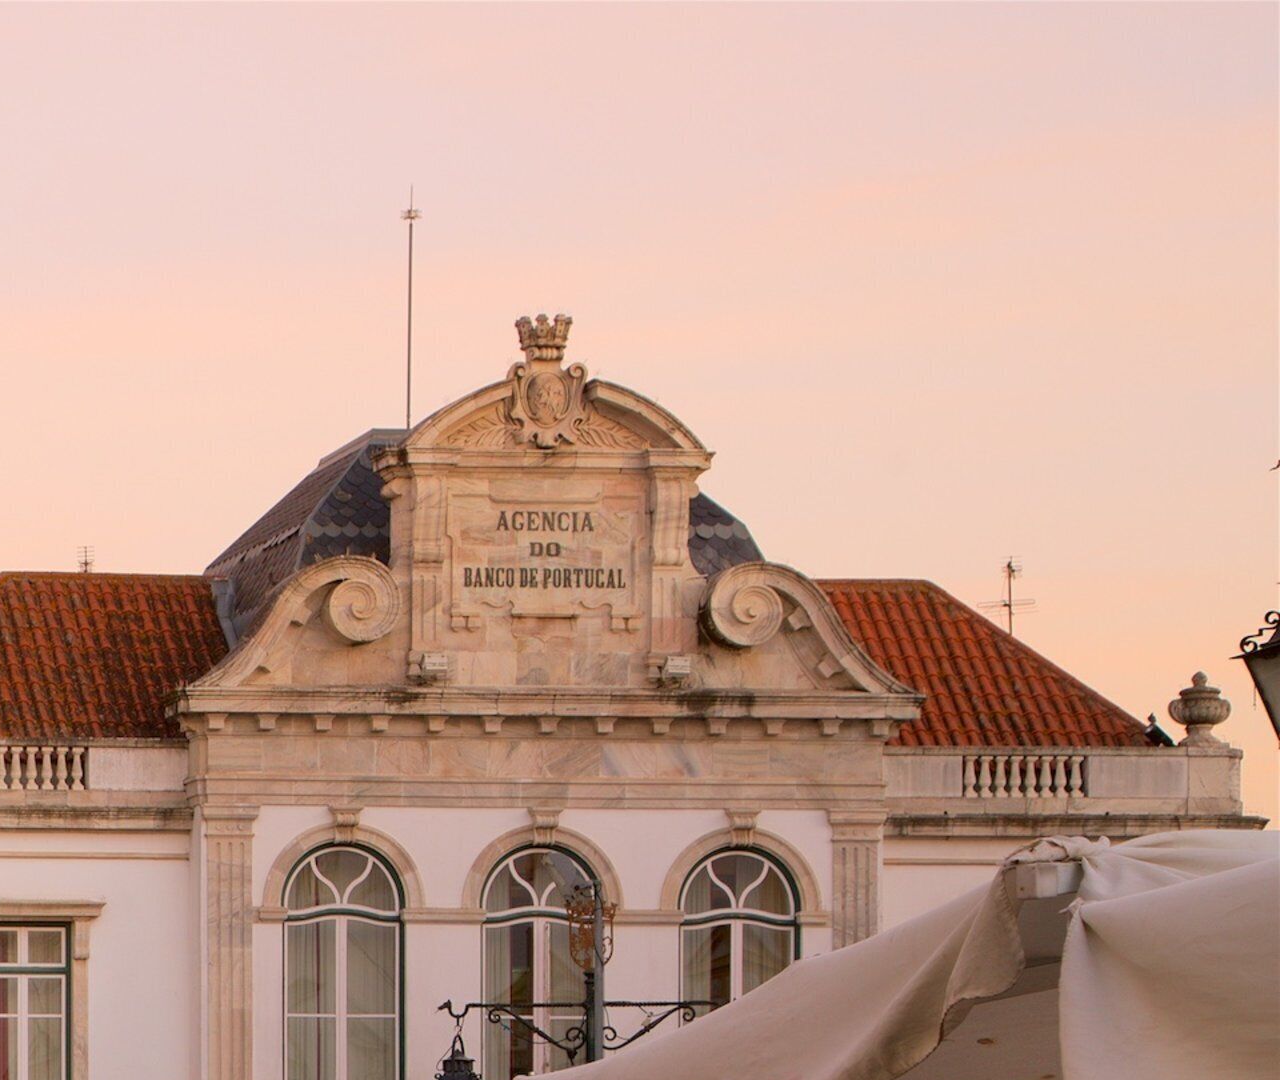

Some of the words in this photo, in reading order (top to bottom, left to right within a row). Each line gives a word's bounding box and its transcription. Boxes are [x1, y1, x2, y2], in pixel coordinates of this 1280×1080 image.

[496, 510, 594, 533] AGENCIA
[529, 542, 562, 557] DO
[463, 567, 515, 588] BANCO
[519, 567, 539, 588] DE
[543, 568, 626, 590] PORTUGAL
